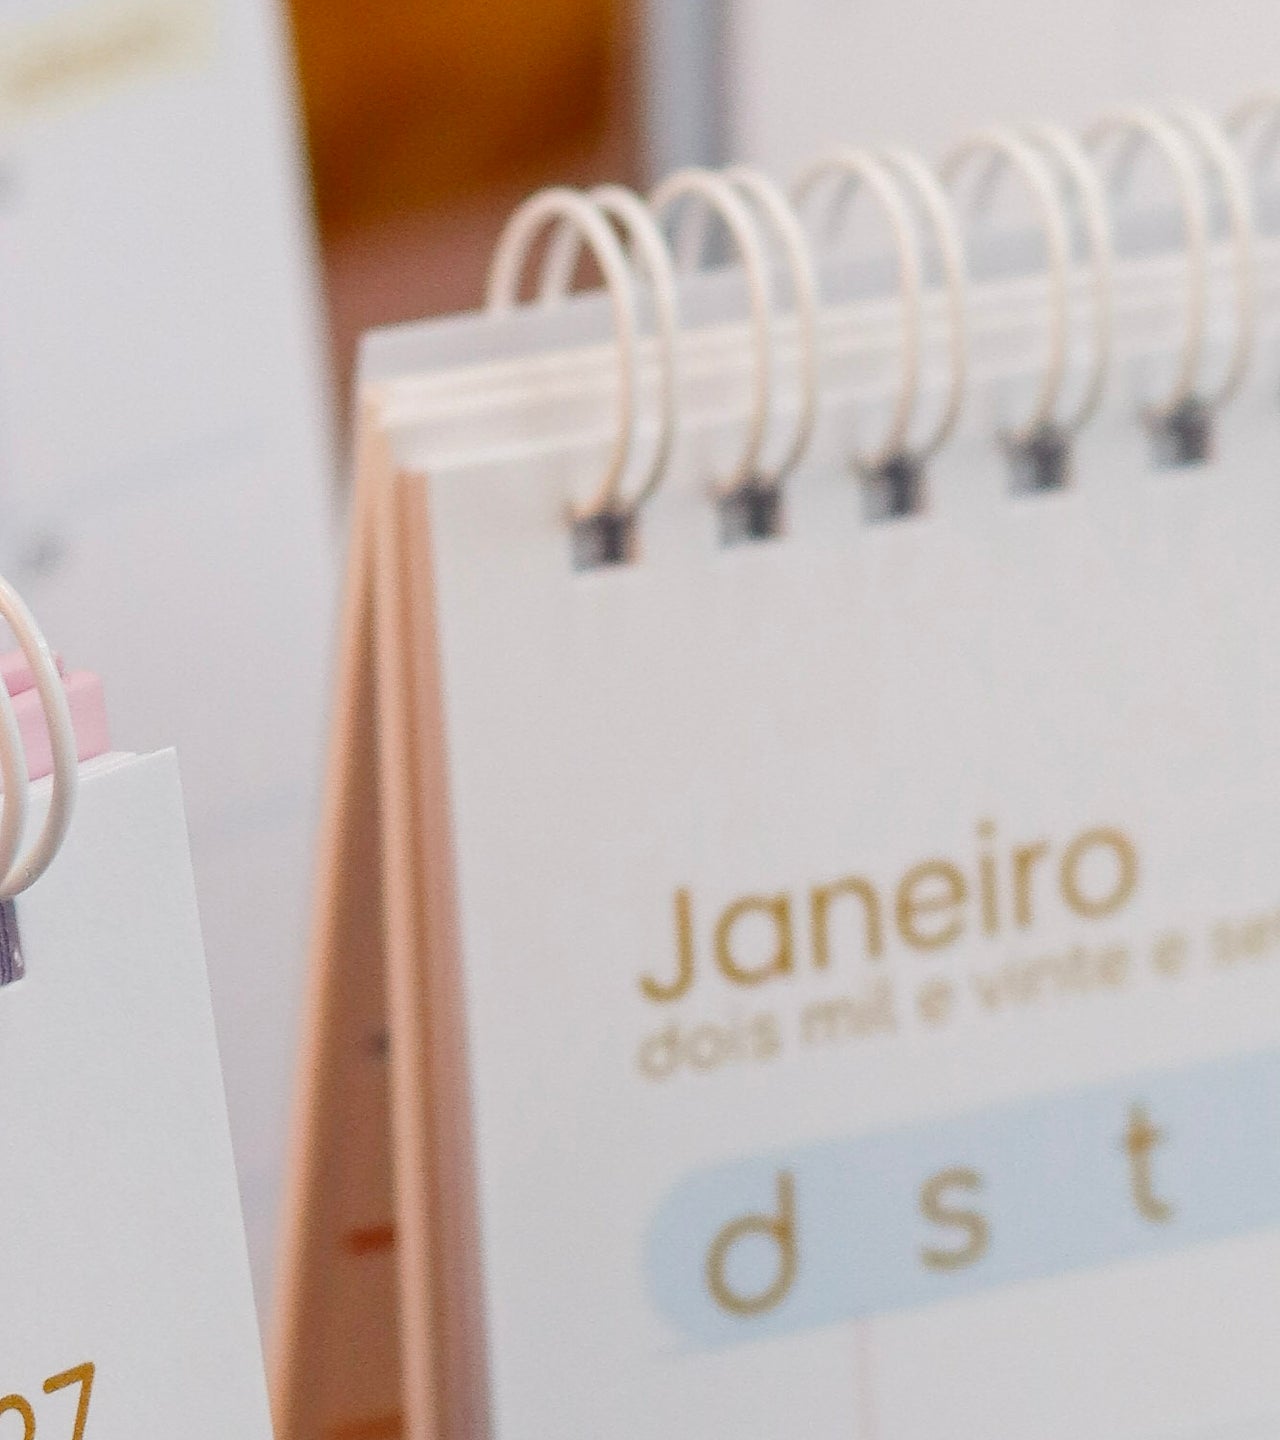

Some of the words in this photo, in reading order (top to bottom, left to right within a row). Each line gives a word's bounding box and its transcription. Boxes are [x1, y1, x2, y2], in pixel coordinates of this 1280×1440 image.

[636, 819, 1142, 1006] Janeiro
[635, 1012, 784, 1082] dois
[800, 978, 898, 1045] mil
[915, 974, 957, 1028] e
[976, 942, 1133, 1014] vinte
[701, 1168, 803, 1320] d
[915, 1163, 994, 1276] s
[1119, 1102, 1173, 1223] t
